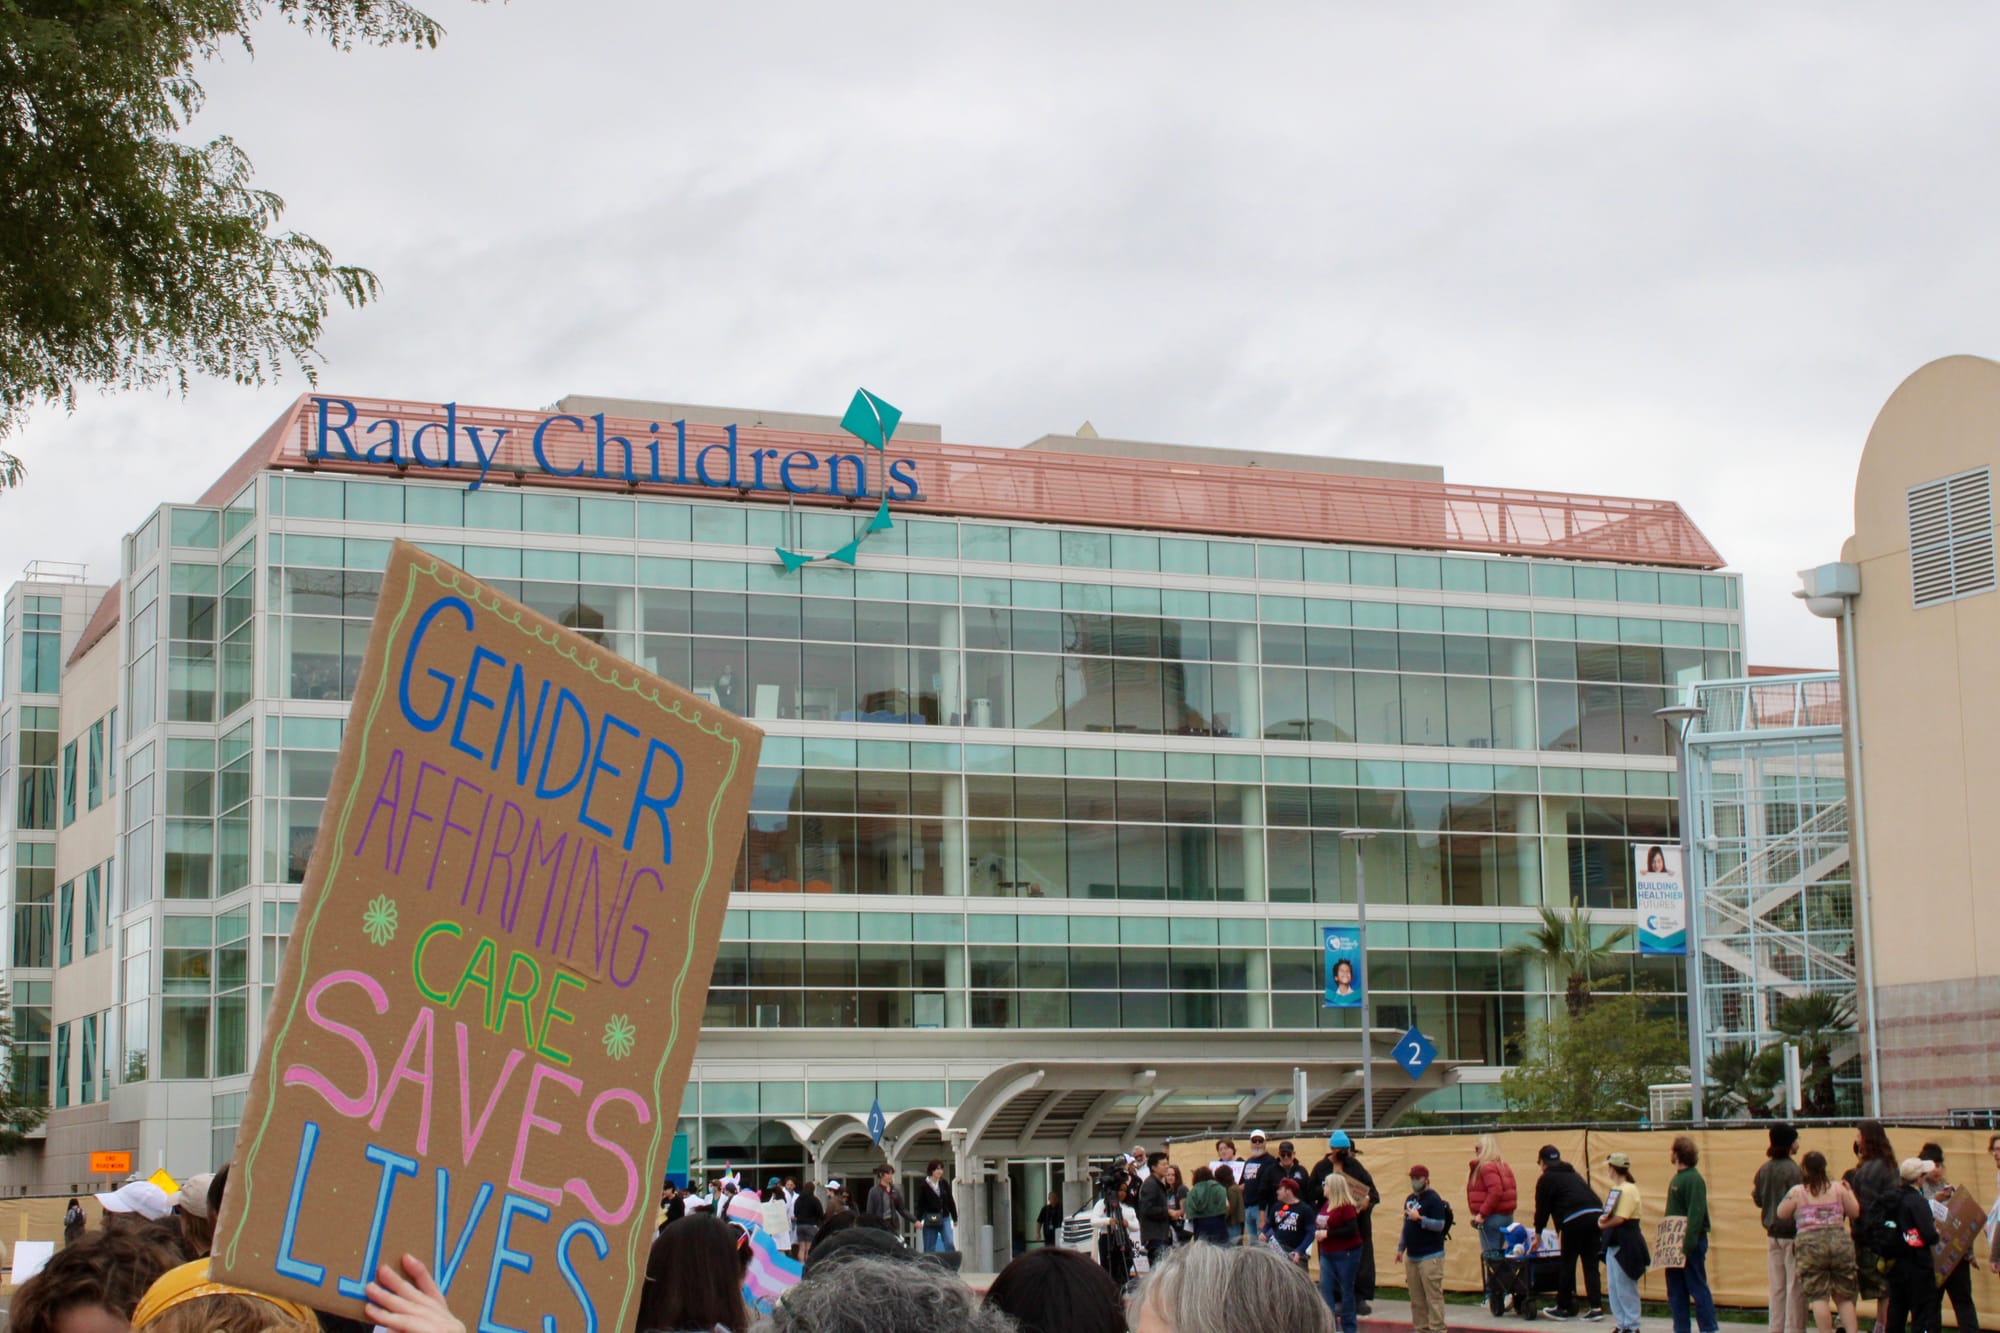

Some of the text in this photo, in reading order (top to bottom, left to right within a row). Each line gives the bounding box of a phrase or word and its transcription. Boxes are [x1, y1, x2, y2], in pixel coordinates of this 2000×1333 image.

[310, 397, 510, 491] Rady
[399, 595, 685, 867] GENDER
[354, 748, 665, 989] AFFIRMING
[1637, 881, 1679, 890] BUILDING
[1637, 890, 1684, 899] HEALTHIER
[1638, 900, 1676, 909] FUTURES
[412, 920, 588, 1066] CARE
[283, 968, 651, 1226] SAVES
[1408, 1042, 1422, 1065] 2
[872, 1113, 879, 1133] 2
[274, 1120, 609, 1333] LIVES
